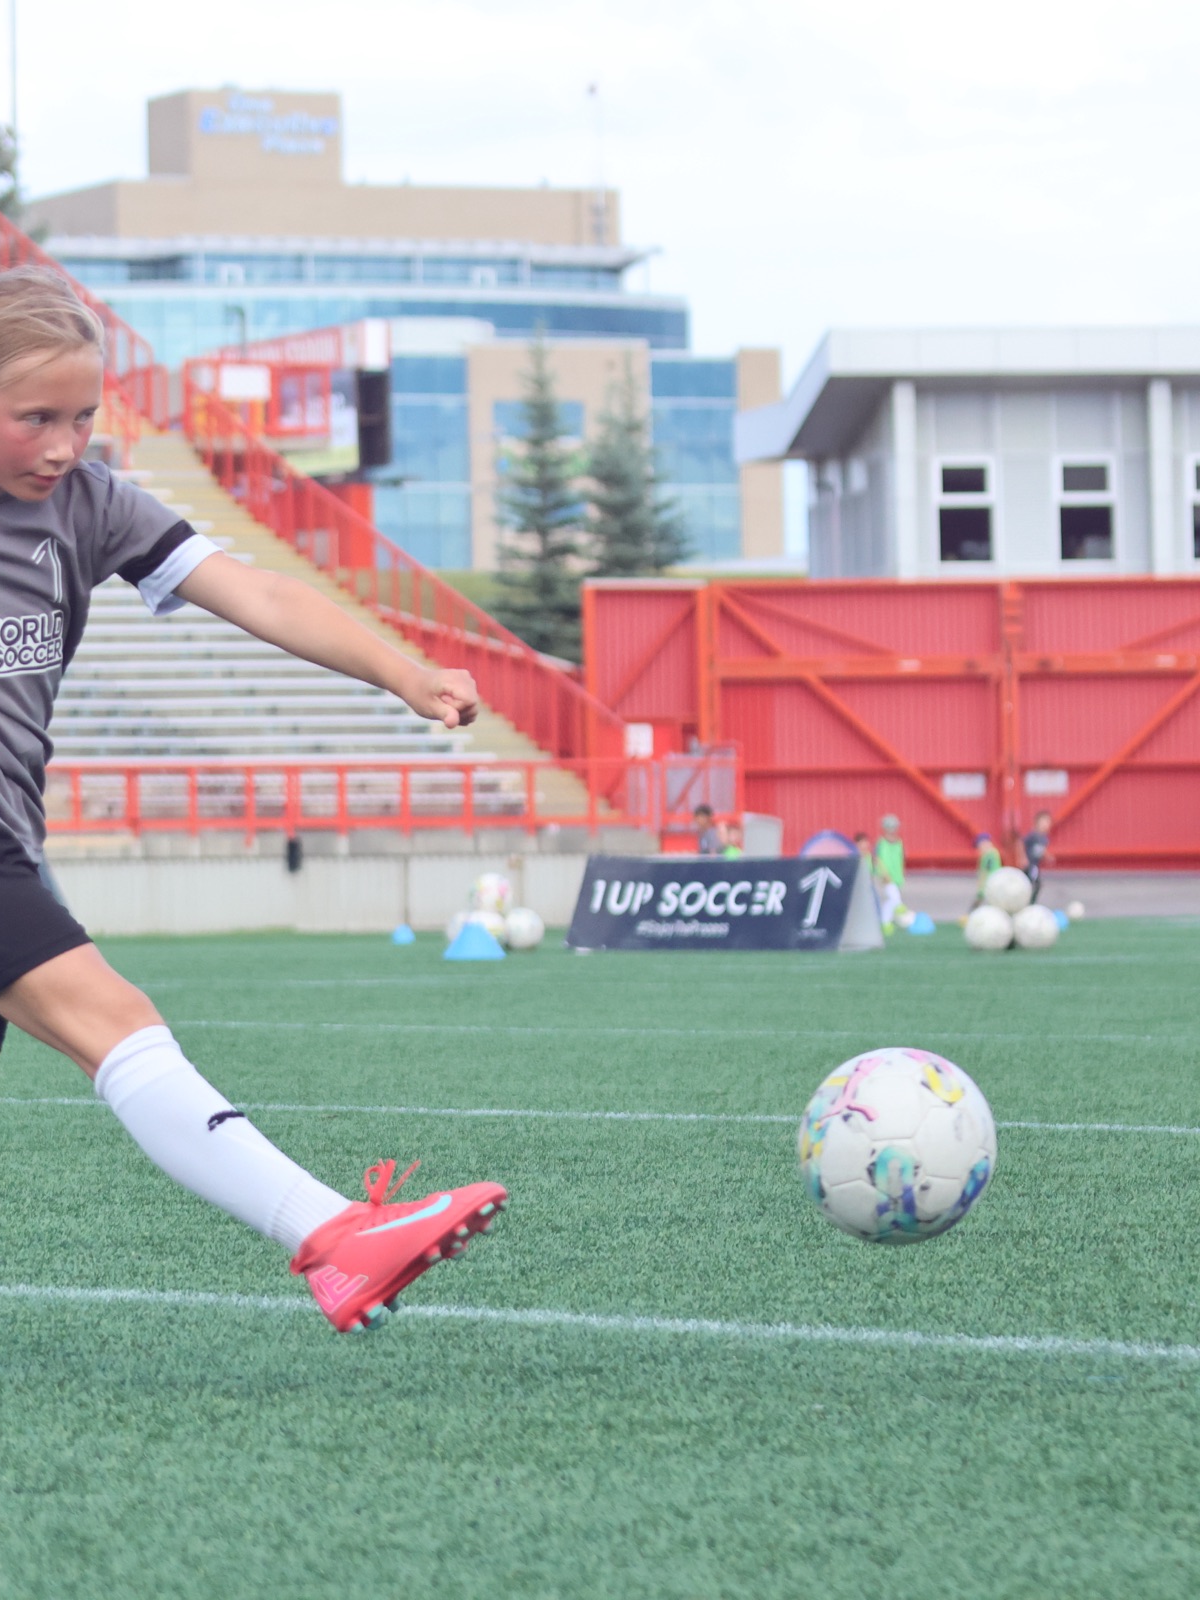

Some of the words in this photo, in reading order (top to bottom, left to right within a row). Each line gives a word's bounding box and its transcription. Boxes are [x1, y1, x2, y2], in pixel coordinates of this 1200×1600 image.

[589, 878, 607, 914] 1
[606, 879, 654, 916] UP
[656, 880, 787, 917] SOCCER
